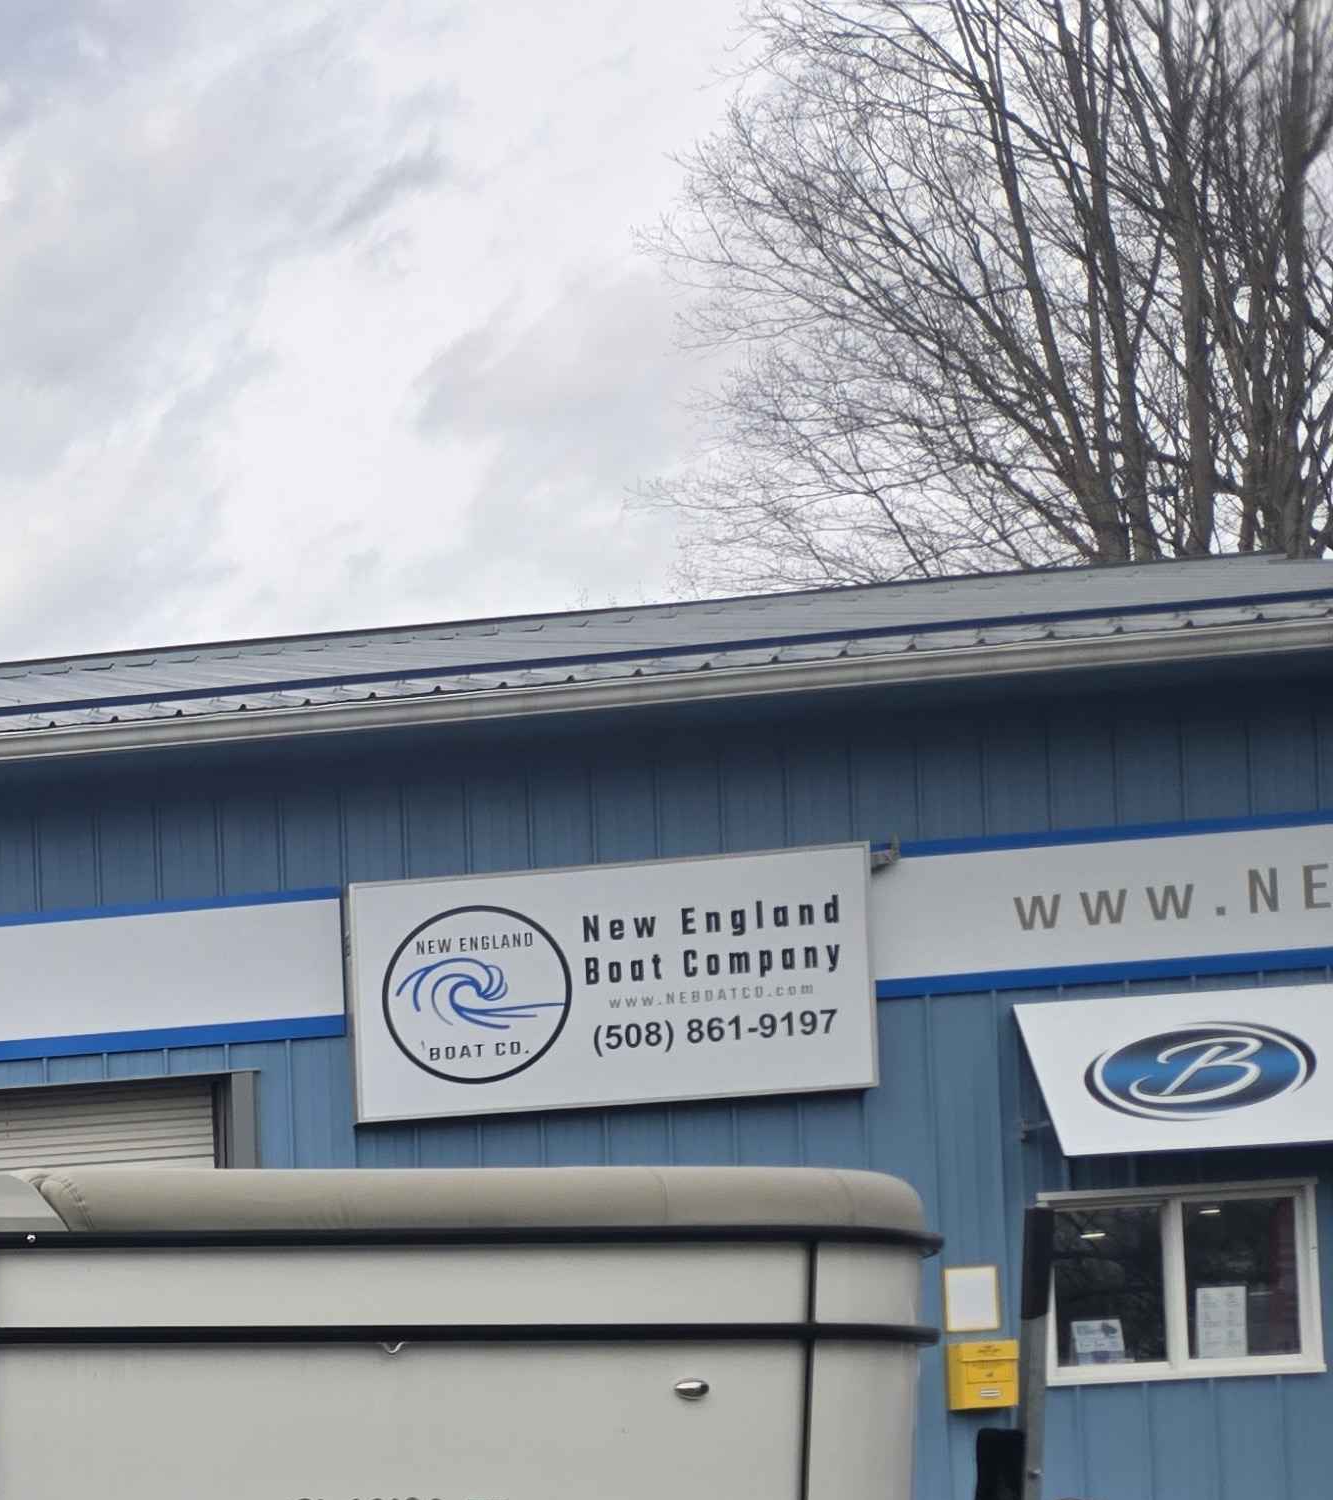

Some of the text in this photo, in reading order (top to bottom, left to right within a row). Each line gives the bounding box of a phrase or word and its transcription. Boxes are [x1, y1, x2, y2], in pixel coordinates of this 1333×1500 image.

[582, 894, 840, 943] New England
[415, 931, 534, 956] NEW ENGLAND
[584, 941, 841, 986] Boat Company
[608, 983, 814, 1009] www.NEBOATCO.com
[593, 1008, 838, 1057] (508) 861-9197
[429, 1040, 530, 1062] BOAT CO.
